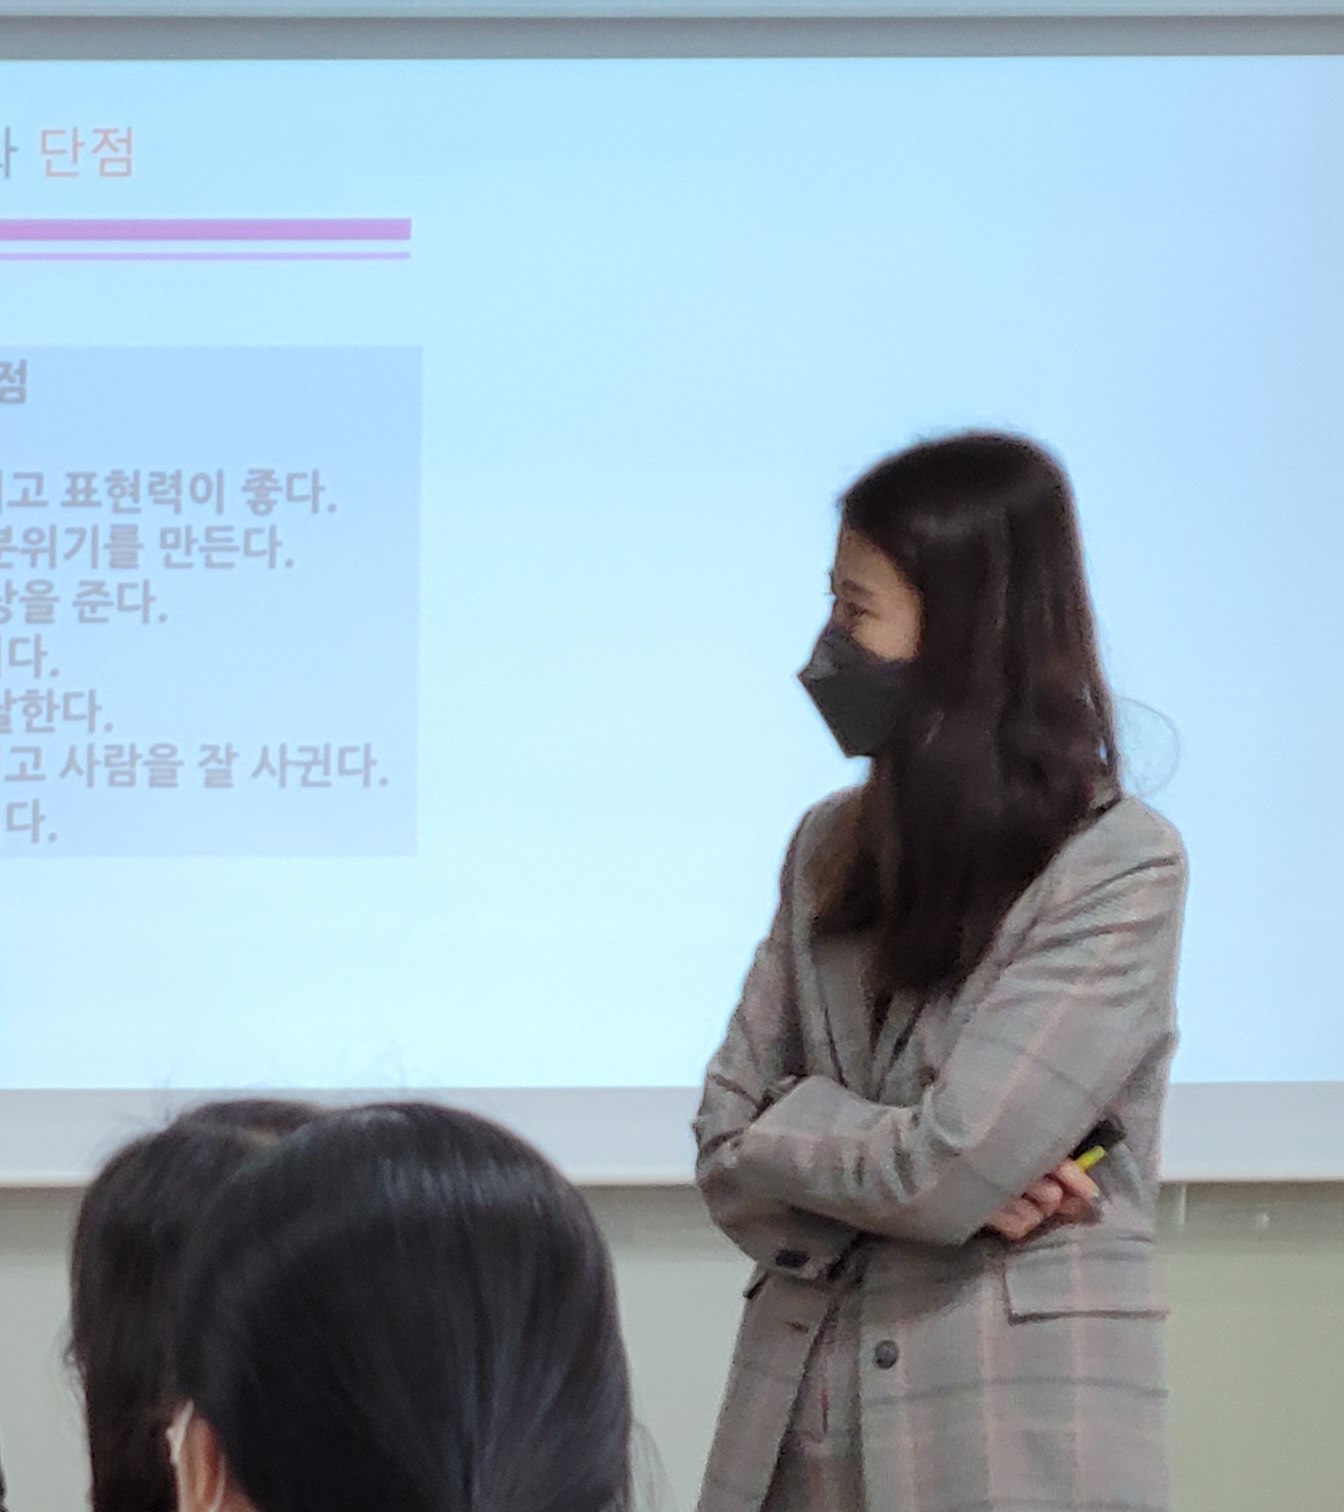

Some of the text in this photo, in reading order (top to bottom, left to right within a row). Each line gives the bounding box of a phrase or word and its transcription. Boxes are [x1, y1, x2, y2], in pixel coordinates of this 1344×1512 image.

[39, 126, 134, 178] 단점
[61, 469, 226, 514] 표현력이
[241, 469, 338, 514] 좋다.
[160, 524, 296, 570] 만든다.
[73, 579, 169, 625] 준다.
[60, 743, 184, 790] 사람을
[198, 743, 238, 788] 잘
[252, 743, 389, 789] 사귄다.
